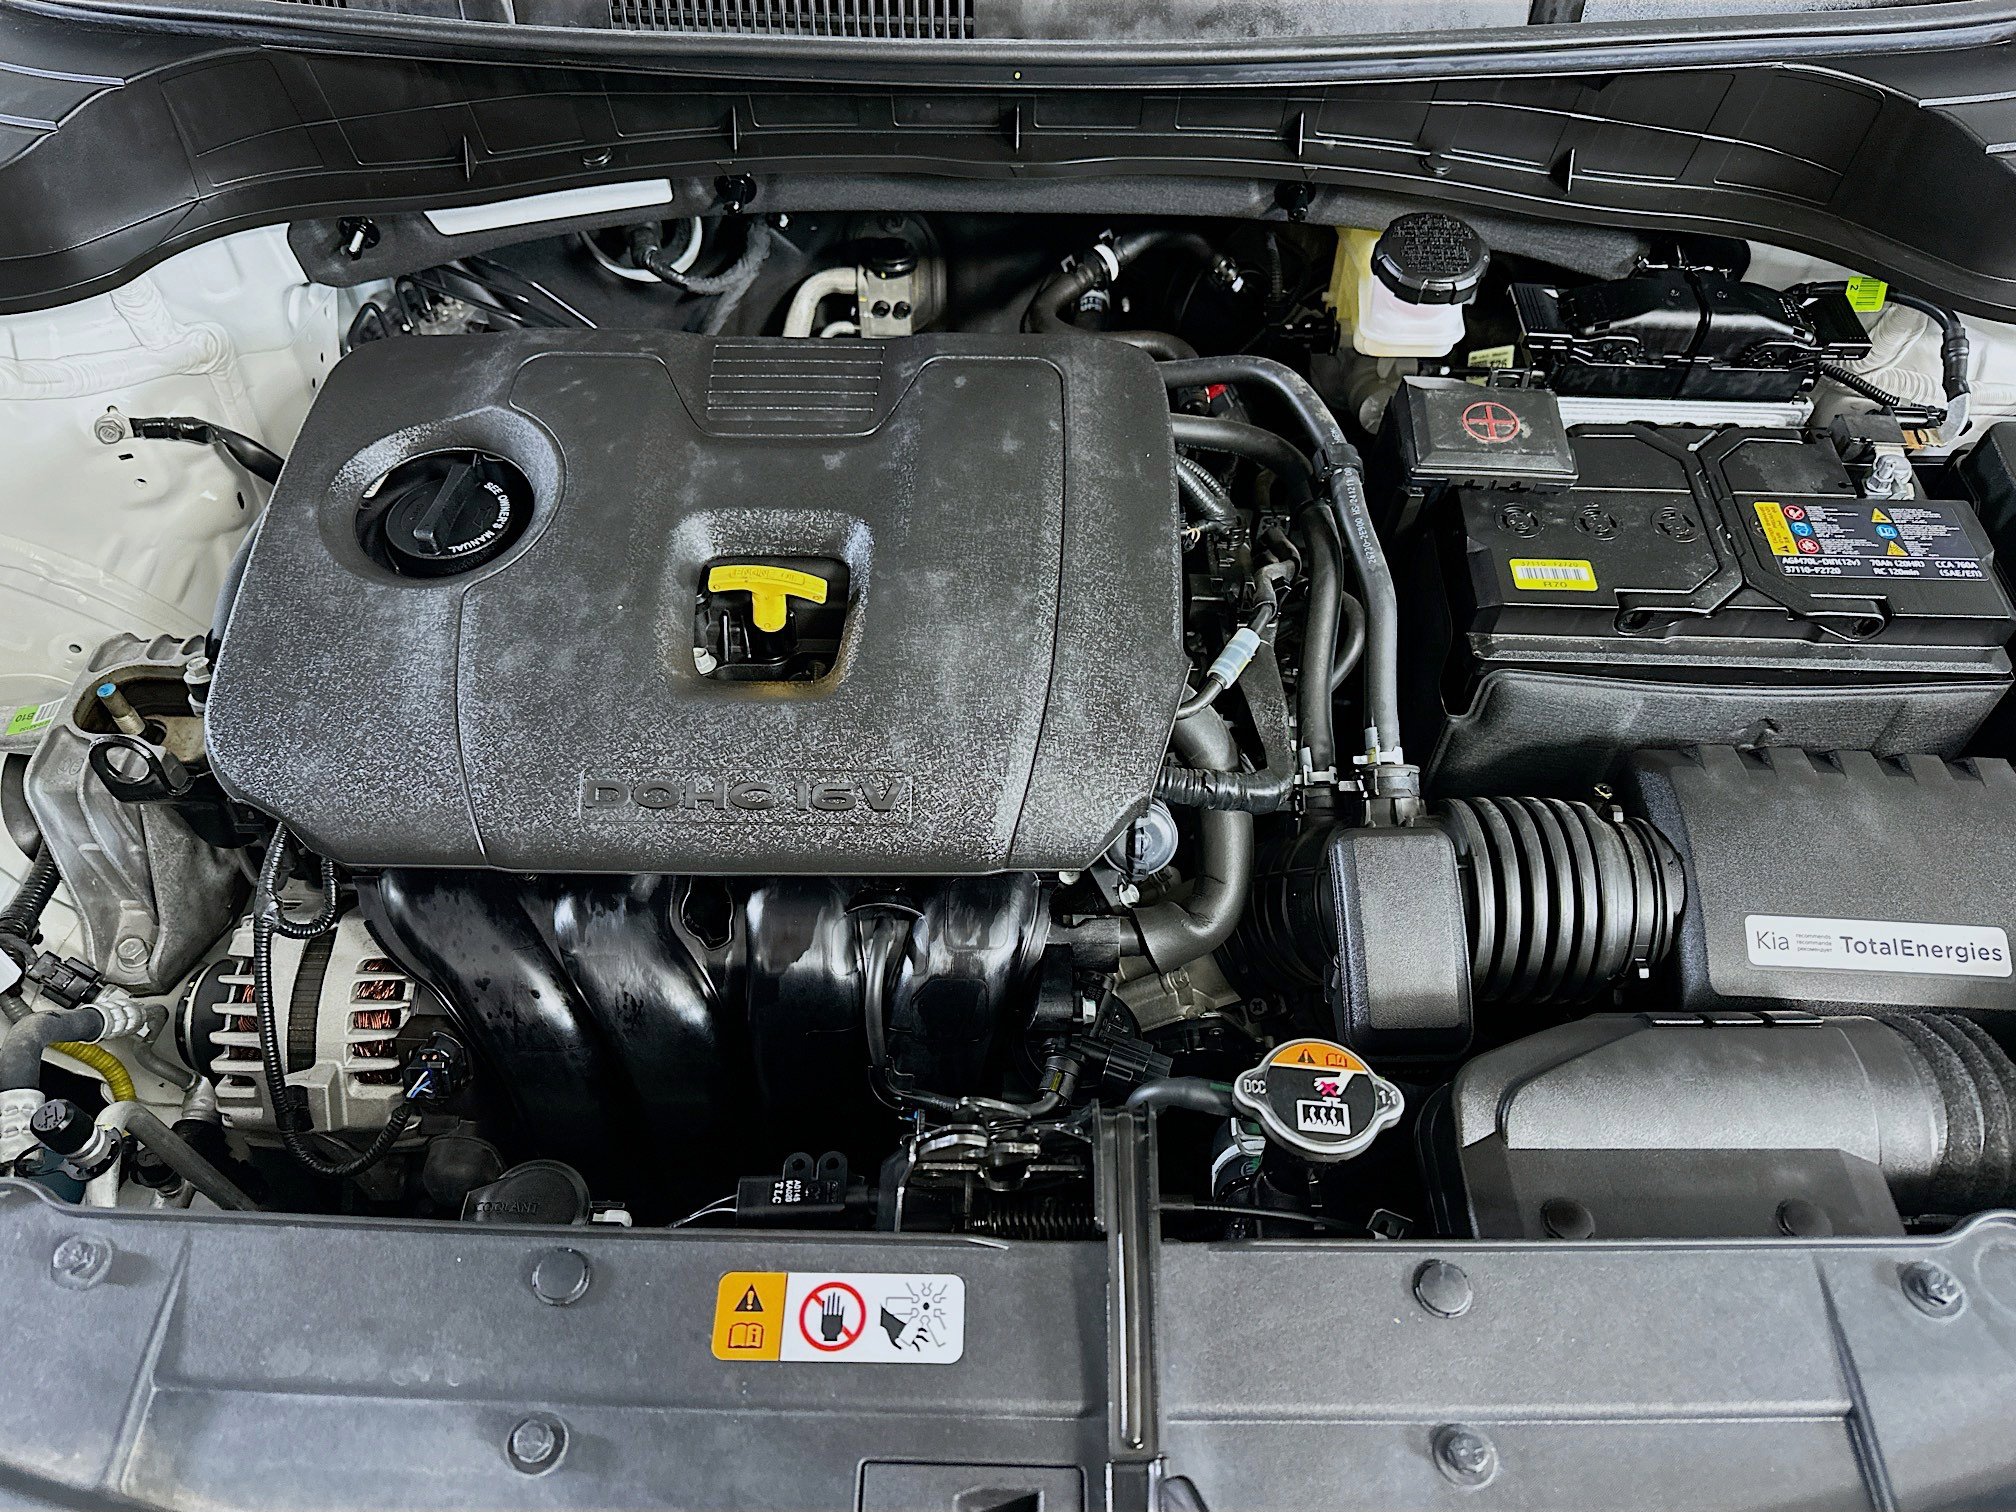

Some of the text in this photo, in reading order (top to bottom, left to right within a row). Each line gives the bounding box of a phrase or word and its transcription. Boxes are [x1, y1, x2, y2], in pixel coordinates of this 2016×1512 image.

[483, 481, 504, 496] SEE
[491, 493, 511, 529] OWNER'S
[447, 529, 496, 554] MANUAL
[1784, 566, 1842, 575] 37110-F2720
[1888, 568, 1920, 576] 120min
[1894, 559, 1926, 568] (20HR)
[584, 779, 905, 812] DOHC 16V
[1756, 931, 1790, 951] Kia
[1839, 935, 2003, 963] TotalEnergies
[1243, 1078, 1267, 1094] DCC
[1378, 1090, 1397, 1105] 1.1
[772, 1181, 784, 1204] TLC
[476, 1201, 541, 1214] COOLANT
